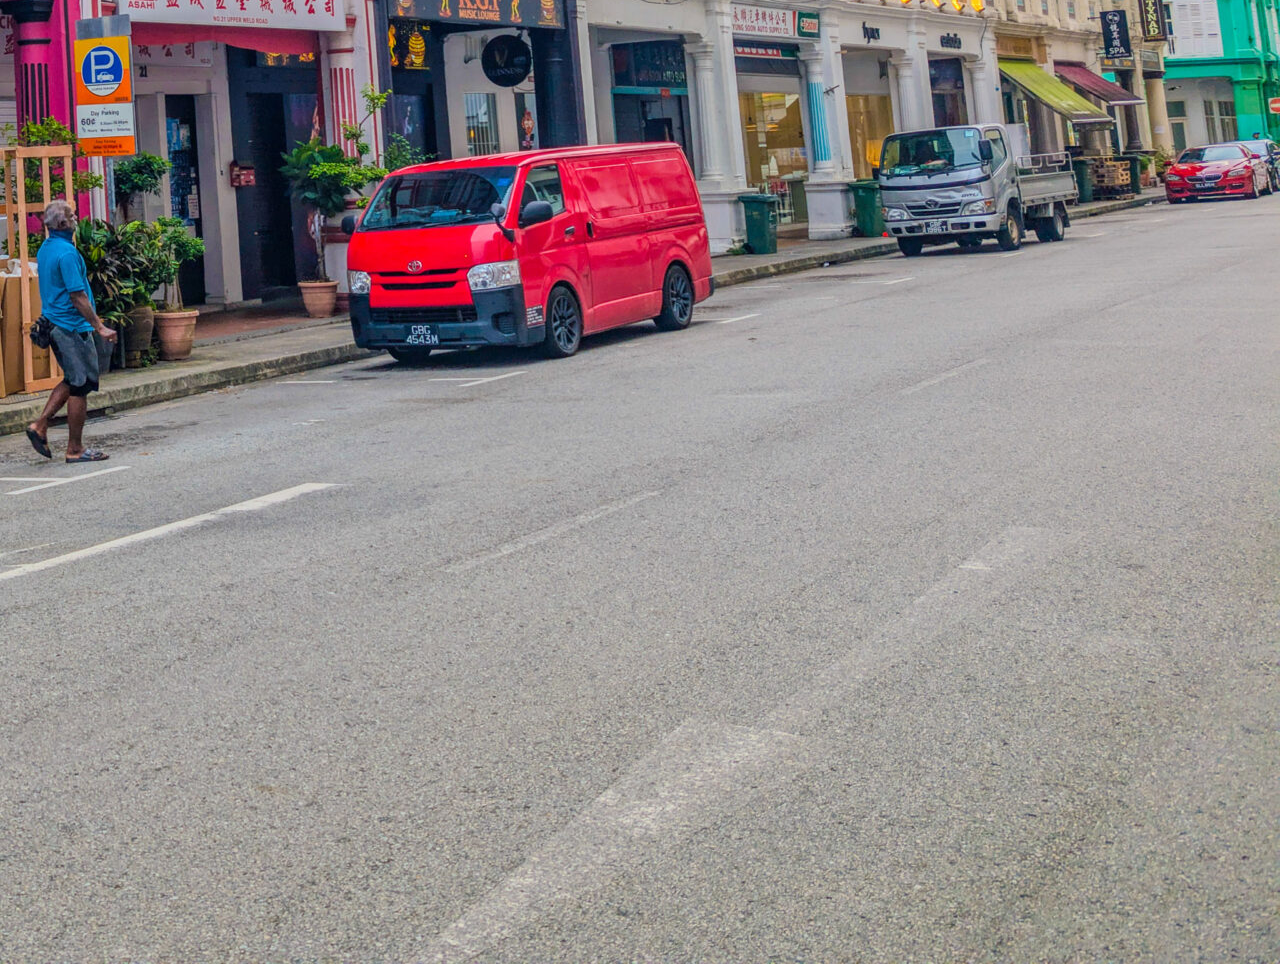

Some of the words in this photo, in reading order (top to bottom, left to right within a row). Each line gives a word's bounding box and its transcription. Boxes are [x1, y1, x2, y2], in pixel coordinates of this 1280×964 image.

[128, 0, 155, 9] ASAHI
[459, 9, 476, 19] MUSIC
[477, 11, 501, 21] LOUNGE
[227, 16, 242, 24] UPPER
[243, 16, 255, 24] WELD
[256, 17, 268, 25] ROAD
[1108, 46, 1125, 55] SPA
[139, 65, 148, 77] 21
[406, 334, 439, 344] 4543M
